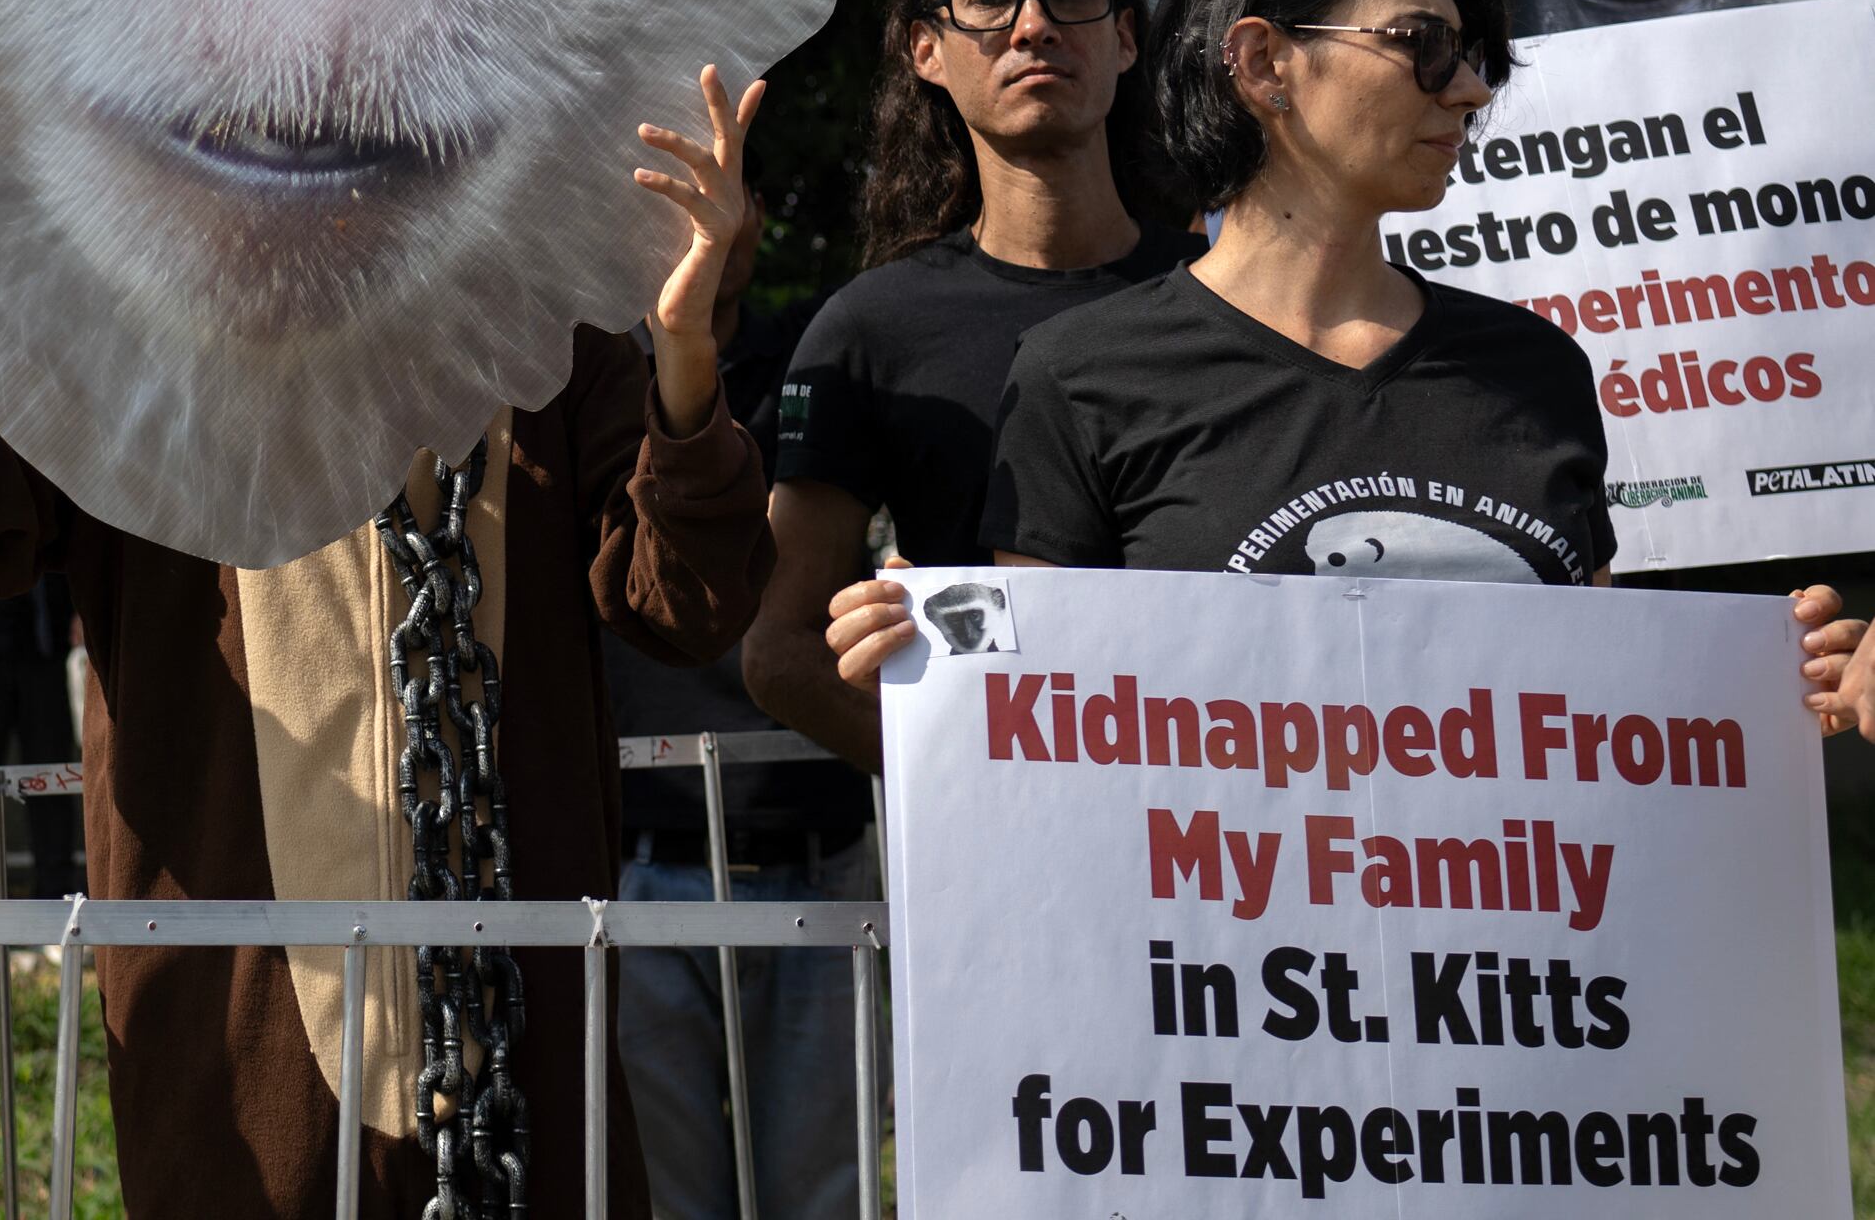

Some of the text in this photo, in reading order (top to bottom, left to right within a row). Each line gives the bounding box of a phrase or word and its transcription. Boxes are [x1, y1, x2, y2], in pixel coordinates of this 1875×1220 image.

[1443, 91, 1767, 185] tengan el
[1592, 189, 1677, 247] de
[1512, 254, 1875, 336] perimento
[1223, 471, 1587, 586] PERIMENTACIÓN EN ANIMALE
[1691, 476, 1702, 484] DE
[984, 673, 1747, 791] Kidnapped From
[1148, 809, 1615, 930] My Family
[1149, 940, 1630, 1049] in St. Kitts
[1011, 1074, 1760, 1200] for Experiments
